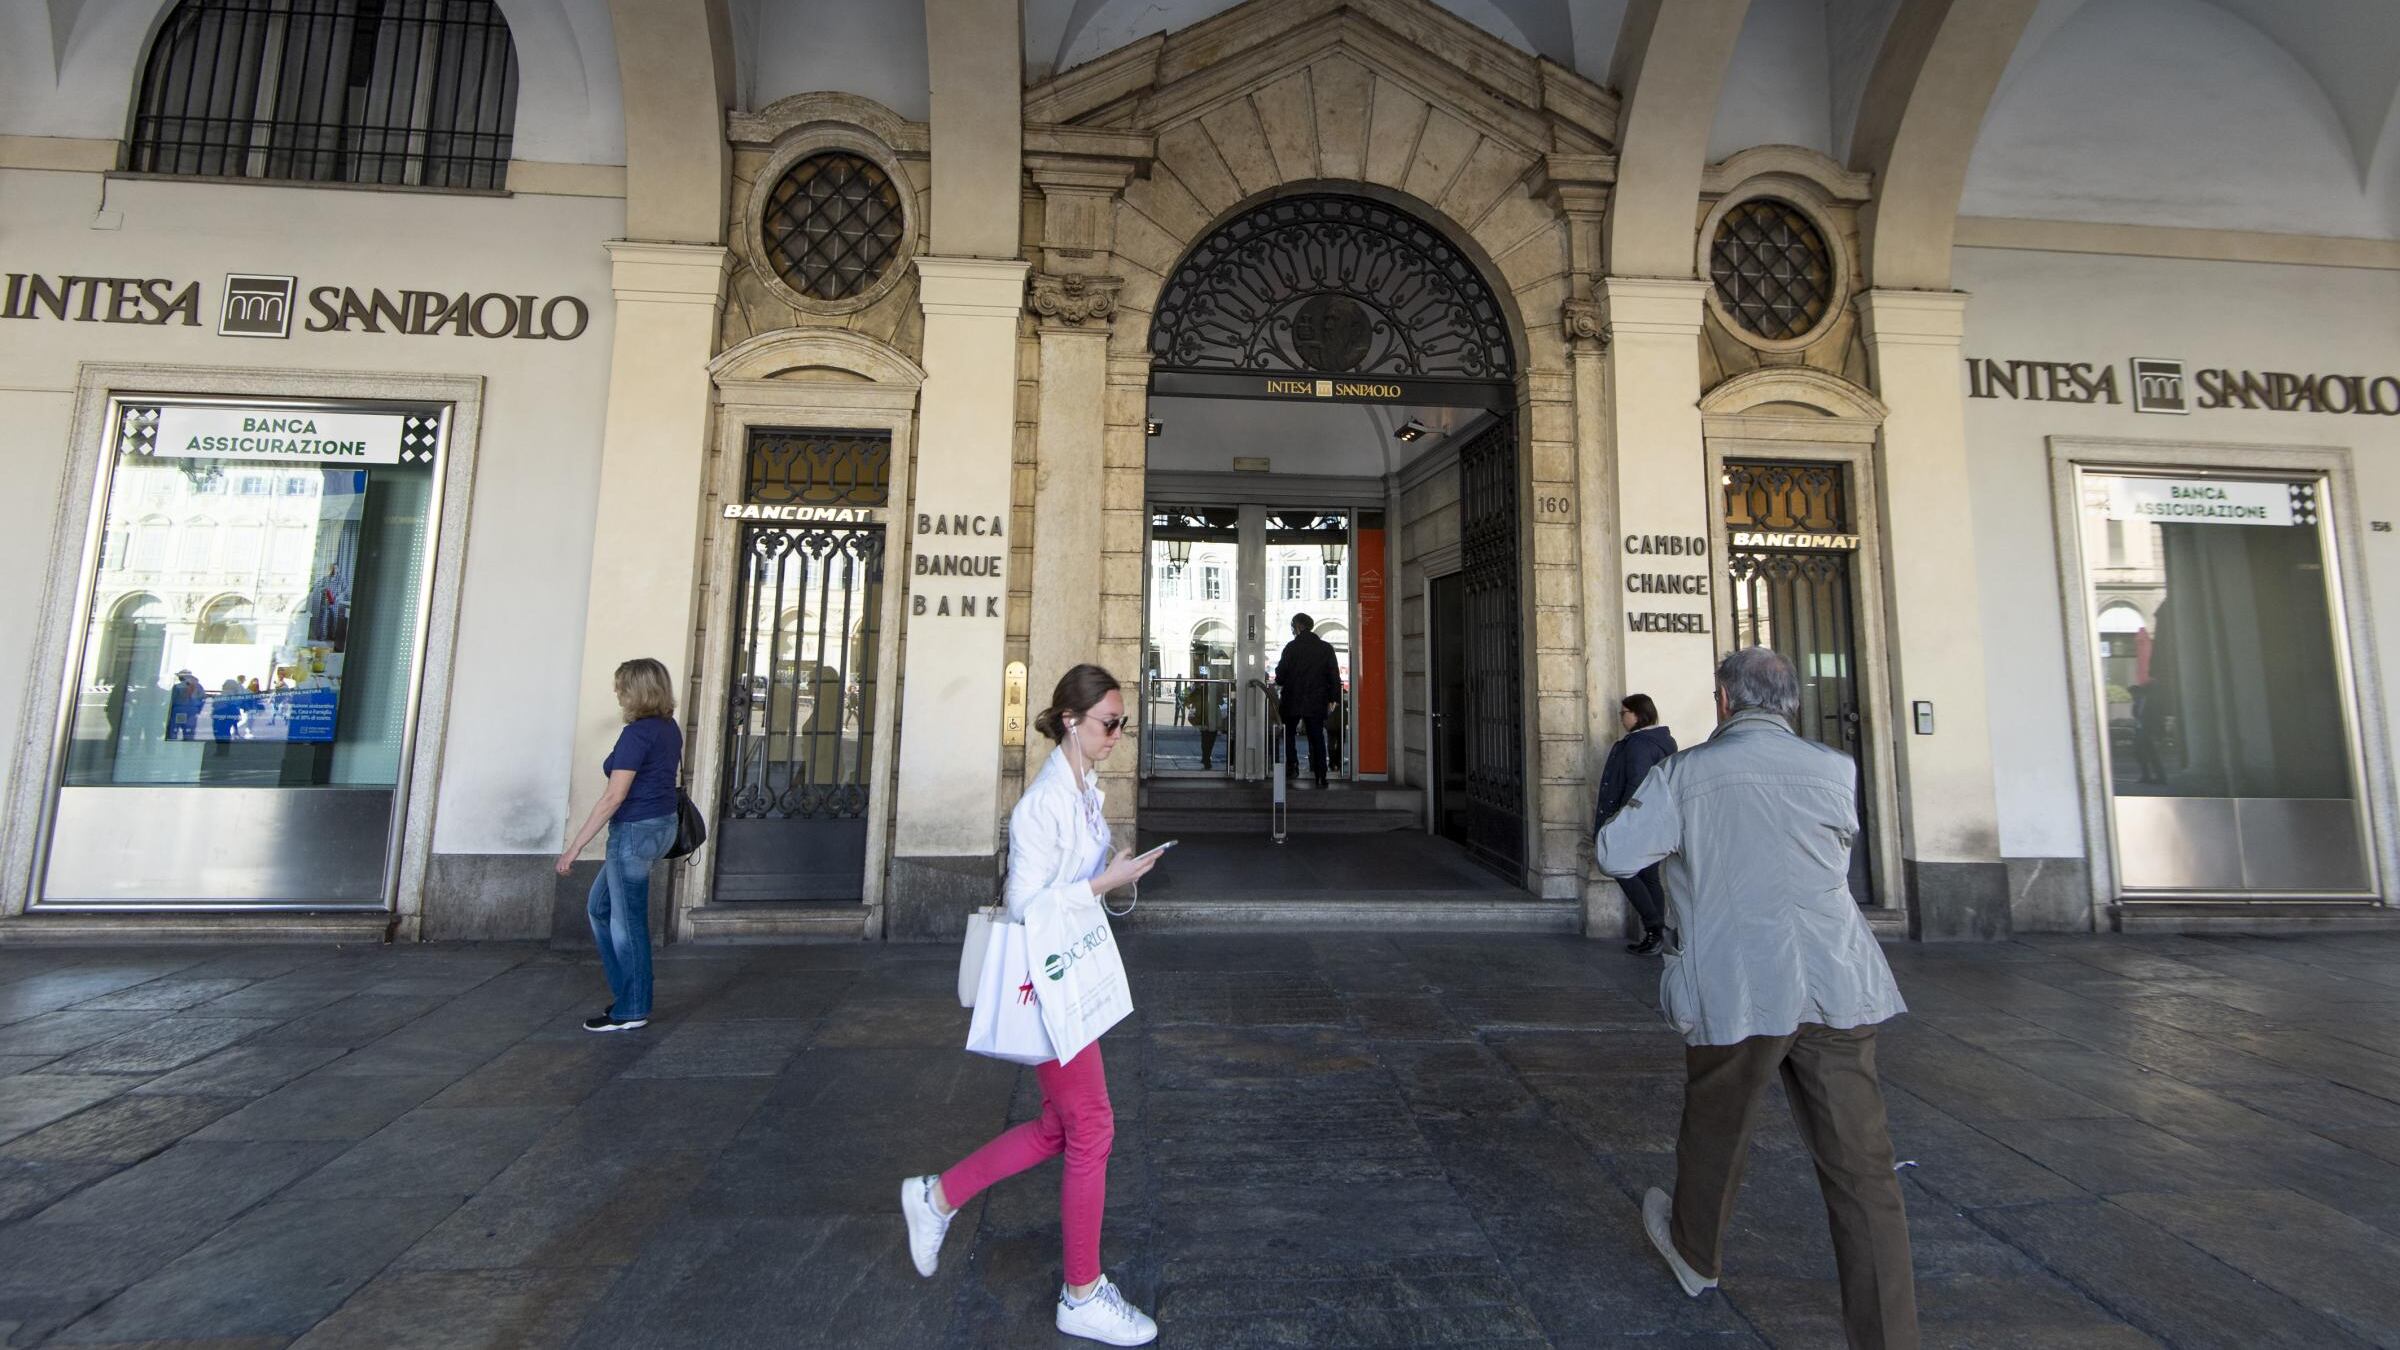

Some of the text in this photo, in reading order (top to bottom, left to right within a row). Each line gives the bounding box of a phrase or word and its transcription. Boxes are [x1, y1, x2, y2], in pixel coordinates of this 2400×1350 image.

[0, 273, 590, 341] INTESA SANPAOLO
[1267, 381, 1401, 398] INTESA SANPAOLO
[1965, 357, 2400, 416] INTESA SANPAOLO
[243, 417, 318, 435] BANCA
[186, 436, 367, 456] ASSICURAZIONE
[2170, 486, 2229, 500] BANCA
[723, 503, 871, 522] BANCOMAT
[1538, 496, 1570, 514] 160
[2133, 502, 2268, 519] ASSICURAZIONE
[917, 513, 1003, 537] BANCA
[1624, 534, 1706, 557] CAMBIO
[1732, 532, 1860, 549] BANCOMAT
[914, 554, 1002, 577] BANQUE
[1626, 573, 1709, 596] CHANGE
[912, 594, 999, 618] BANK
[1628, 611, 1711, 634] WECHSEL
